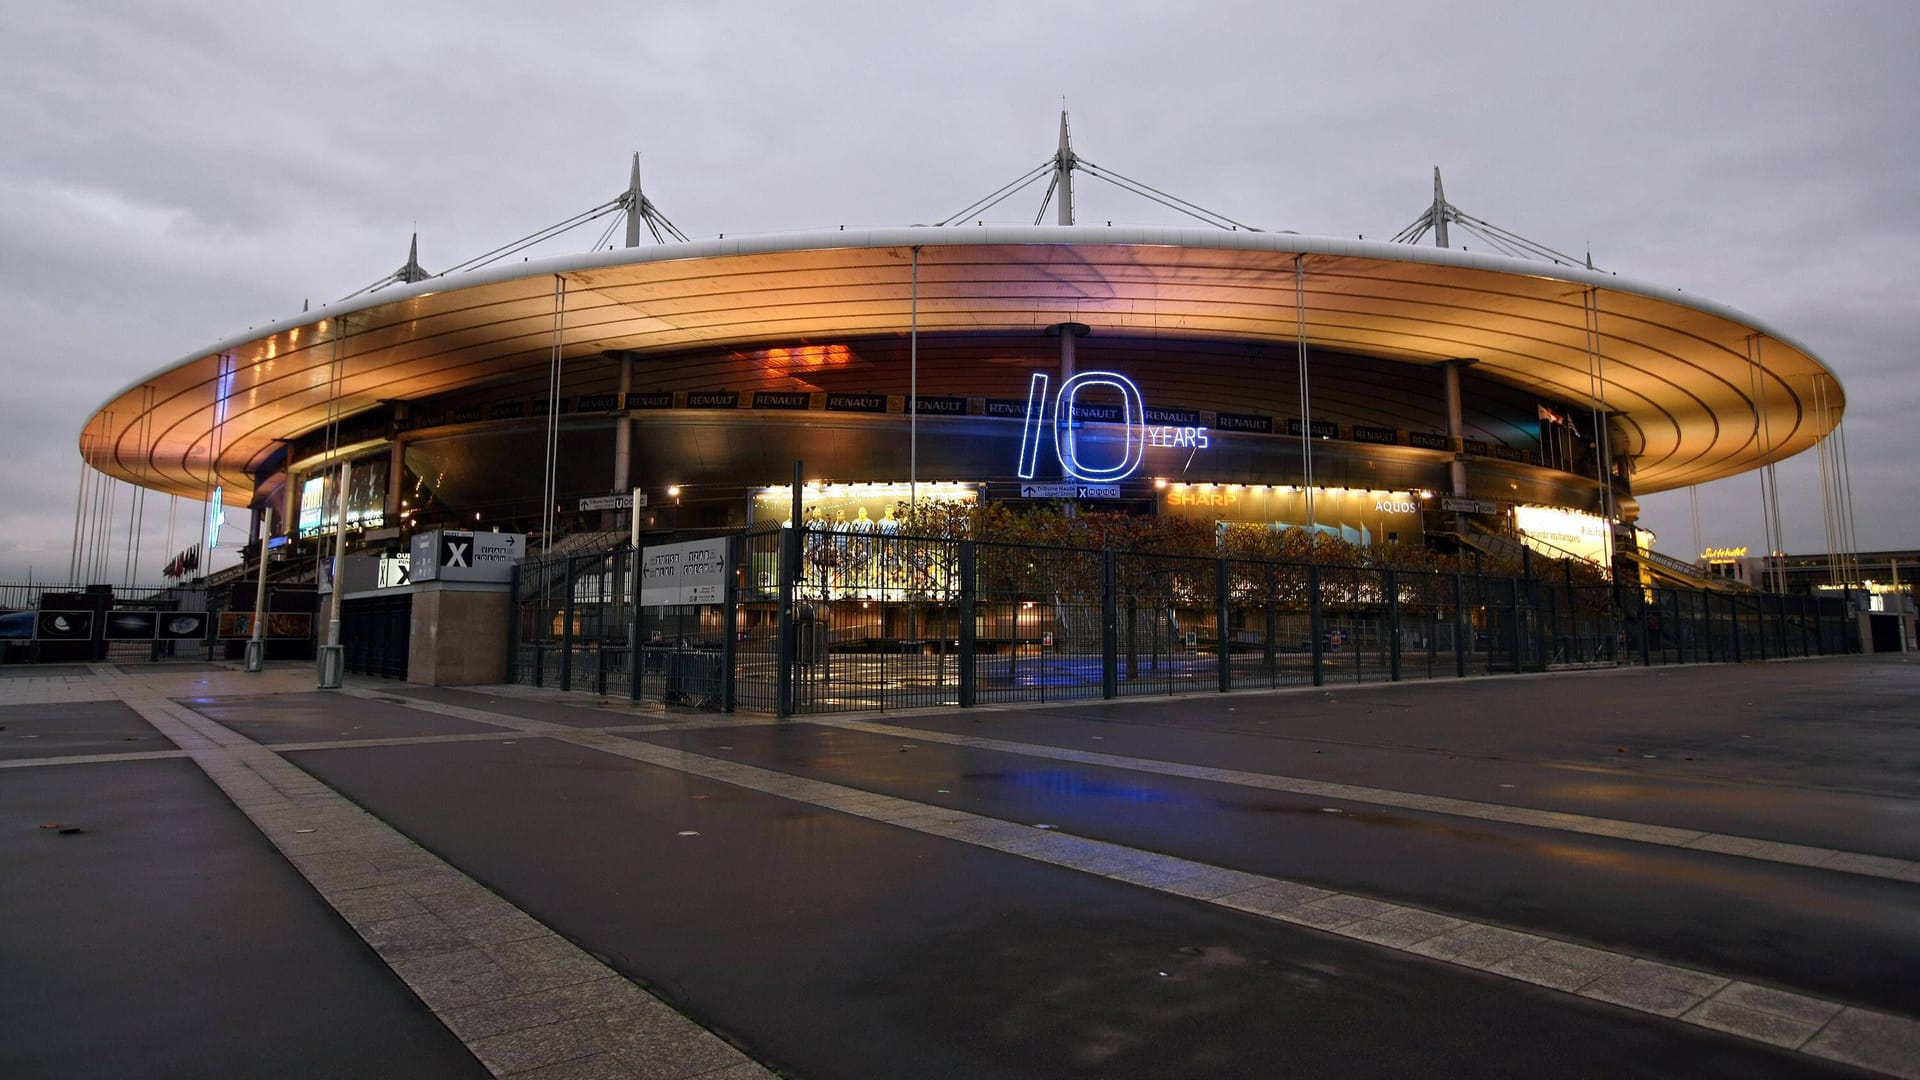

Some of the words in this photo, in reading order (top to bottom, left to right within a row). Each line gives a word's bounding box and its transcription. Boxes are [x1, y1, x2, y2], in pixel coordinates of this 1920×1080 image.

[689, 395, 734, 405] RENAULT
[756, 395, 804, 406] RENAULT
[829, 397, 882, 409] RENAULT
[1070, 405, 1117, 418] RENAULT
[1145, 410, 1195, 423] RENAULT
[1018, 371, 1144, 482] 10
[1148, 426, 1208, 449] YEARS
[1220, 417, 1267, 429] RENAULT
[1356, 429, 1394, 442] RENAULT
[1079, 487, 1087, 498] X
[1167, 493, 1237, 507] SHARP
[1375, 499, 1416, 514] AQUOS
[446, 542, 469, 568] X
